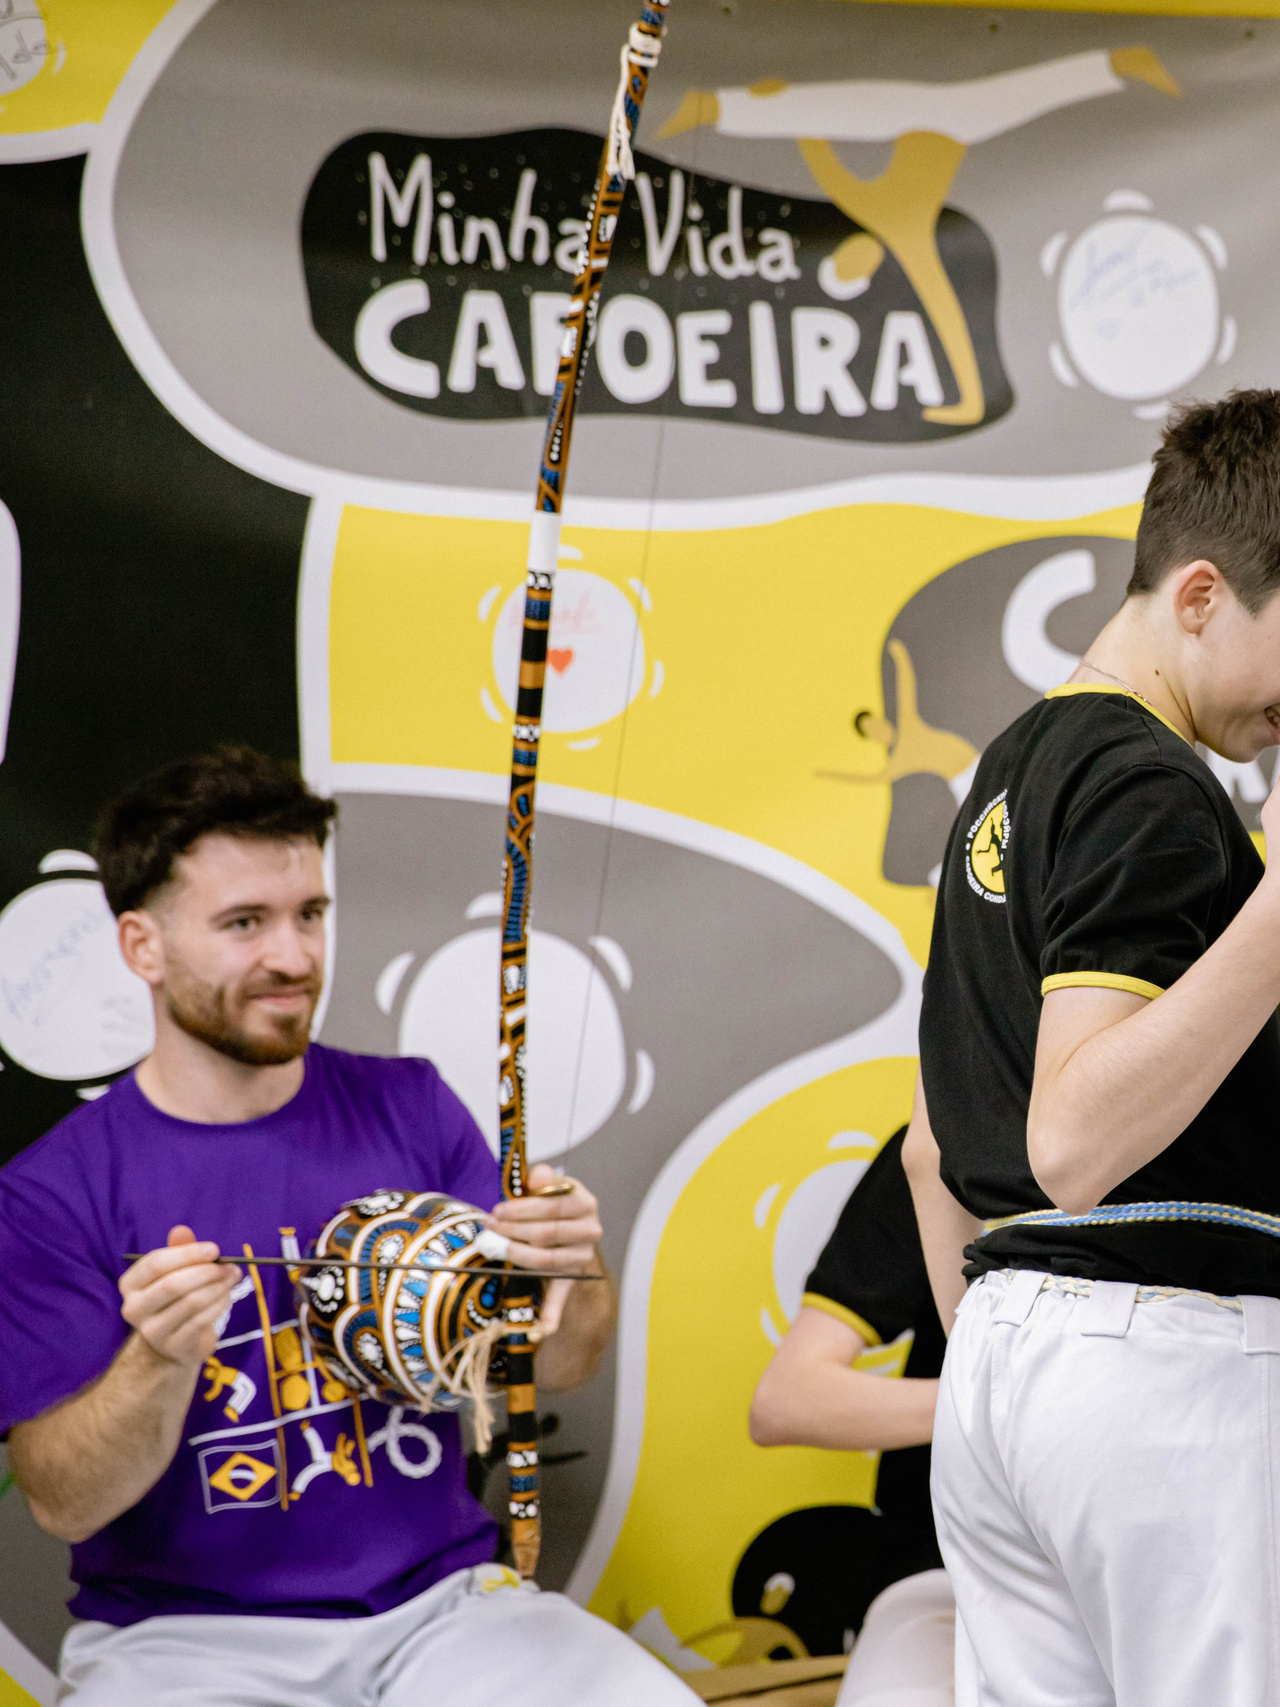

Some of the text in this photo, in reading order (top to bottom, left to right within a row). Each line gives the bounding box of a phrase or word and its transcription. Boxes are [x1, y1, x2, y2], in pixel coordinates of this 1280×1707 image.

[369, 151, 800, 281] Minha Vida
[354, 279, 944, 417] CAPOEIRA
